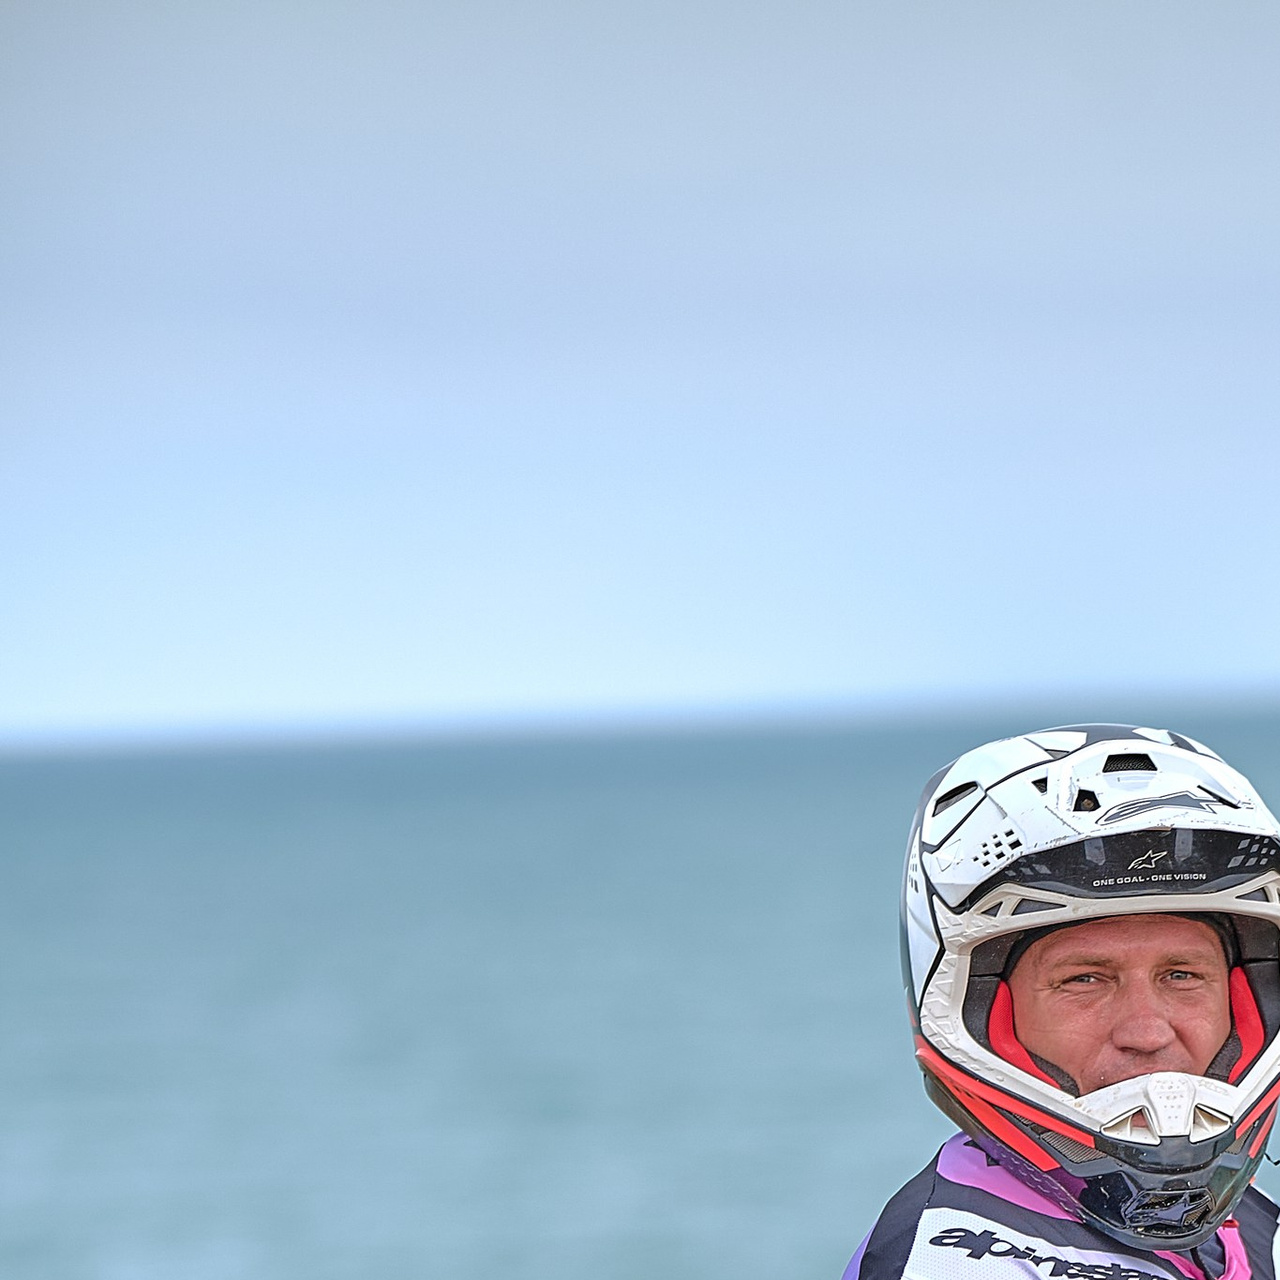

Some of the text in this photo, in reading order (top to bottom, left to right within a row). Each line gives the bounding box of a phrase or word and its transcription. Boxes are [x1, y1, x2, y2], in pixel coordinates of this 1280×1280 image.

[1092, 879, 1115, 887] ONE
[1116, 875, 1145, 885] GOAL
[1151, 874, 1172, 882] ONE
[1173, 872, 1207, 881] VISION
